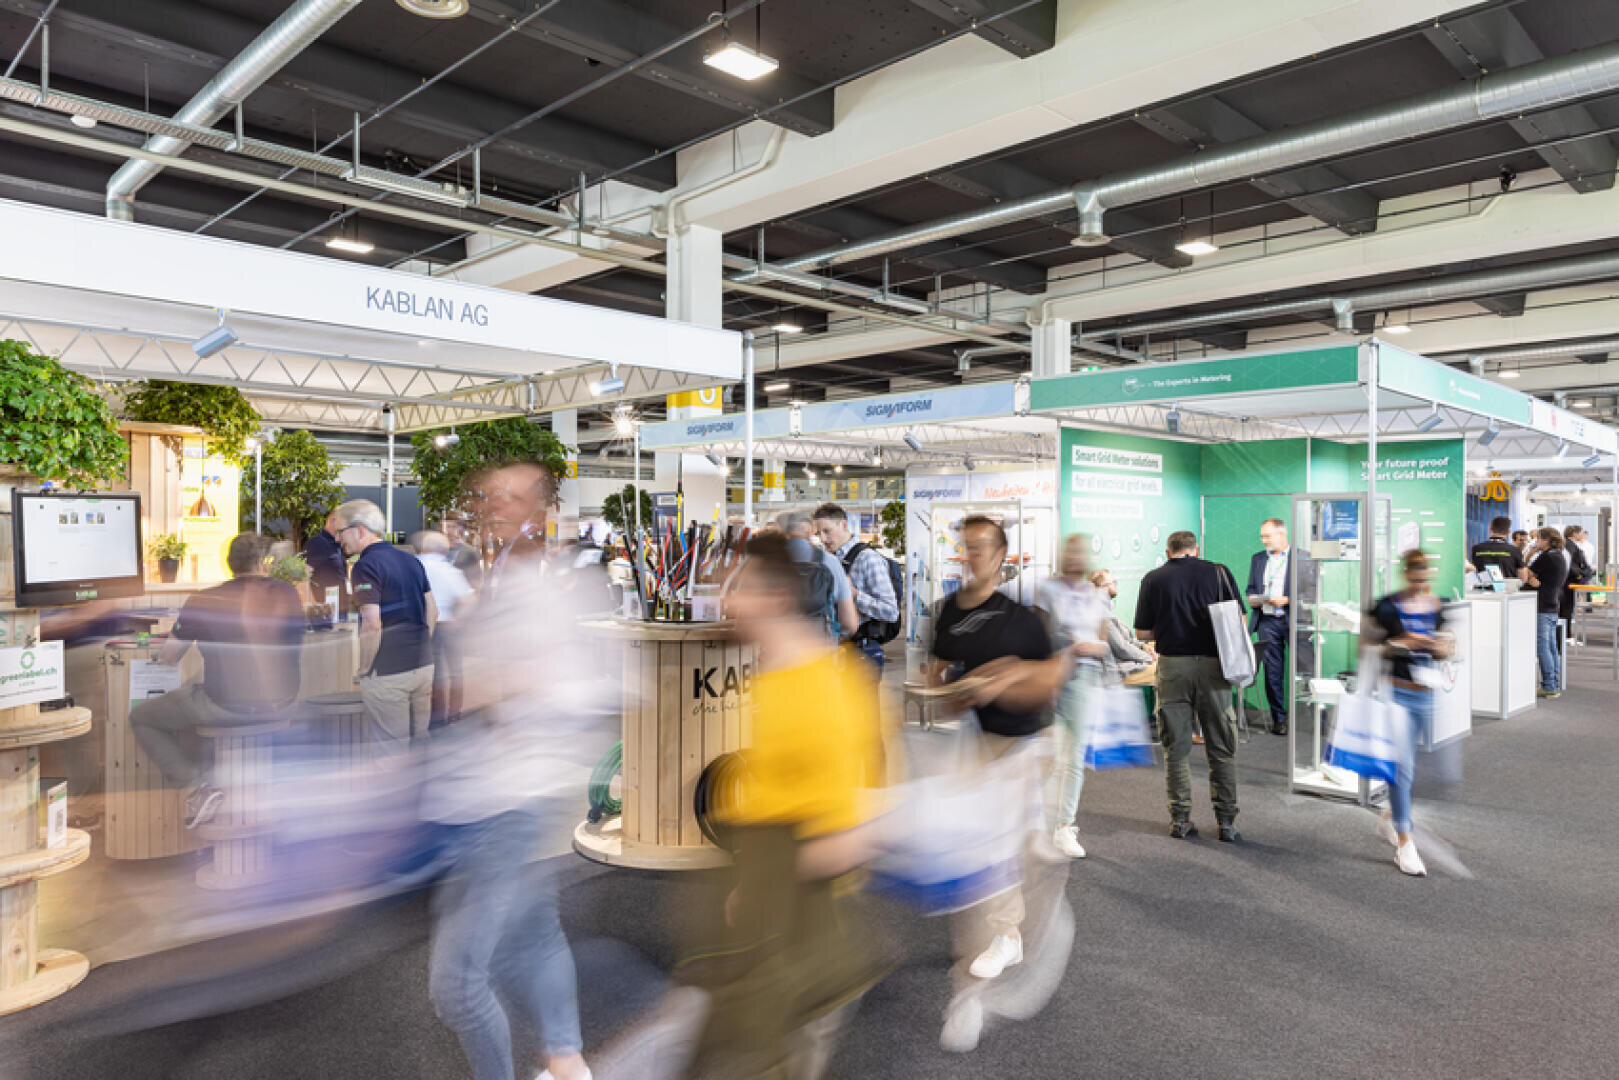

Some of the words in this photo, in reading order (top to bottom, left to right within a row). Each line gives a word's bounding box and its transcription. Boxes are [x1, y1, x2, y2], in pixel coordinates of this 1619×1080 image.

[366, 286, 454, 321] KABLAN
[460, 302, 489, 326] AG
[1075, 448, 1096, 462] Smart
[1385, 458, 1417, 469] future
[1419, 456, 1449, 470] proof
[1393, 470, 1414, 481] Grid
[1416, 469, 1448, 480] Meter
